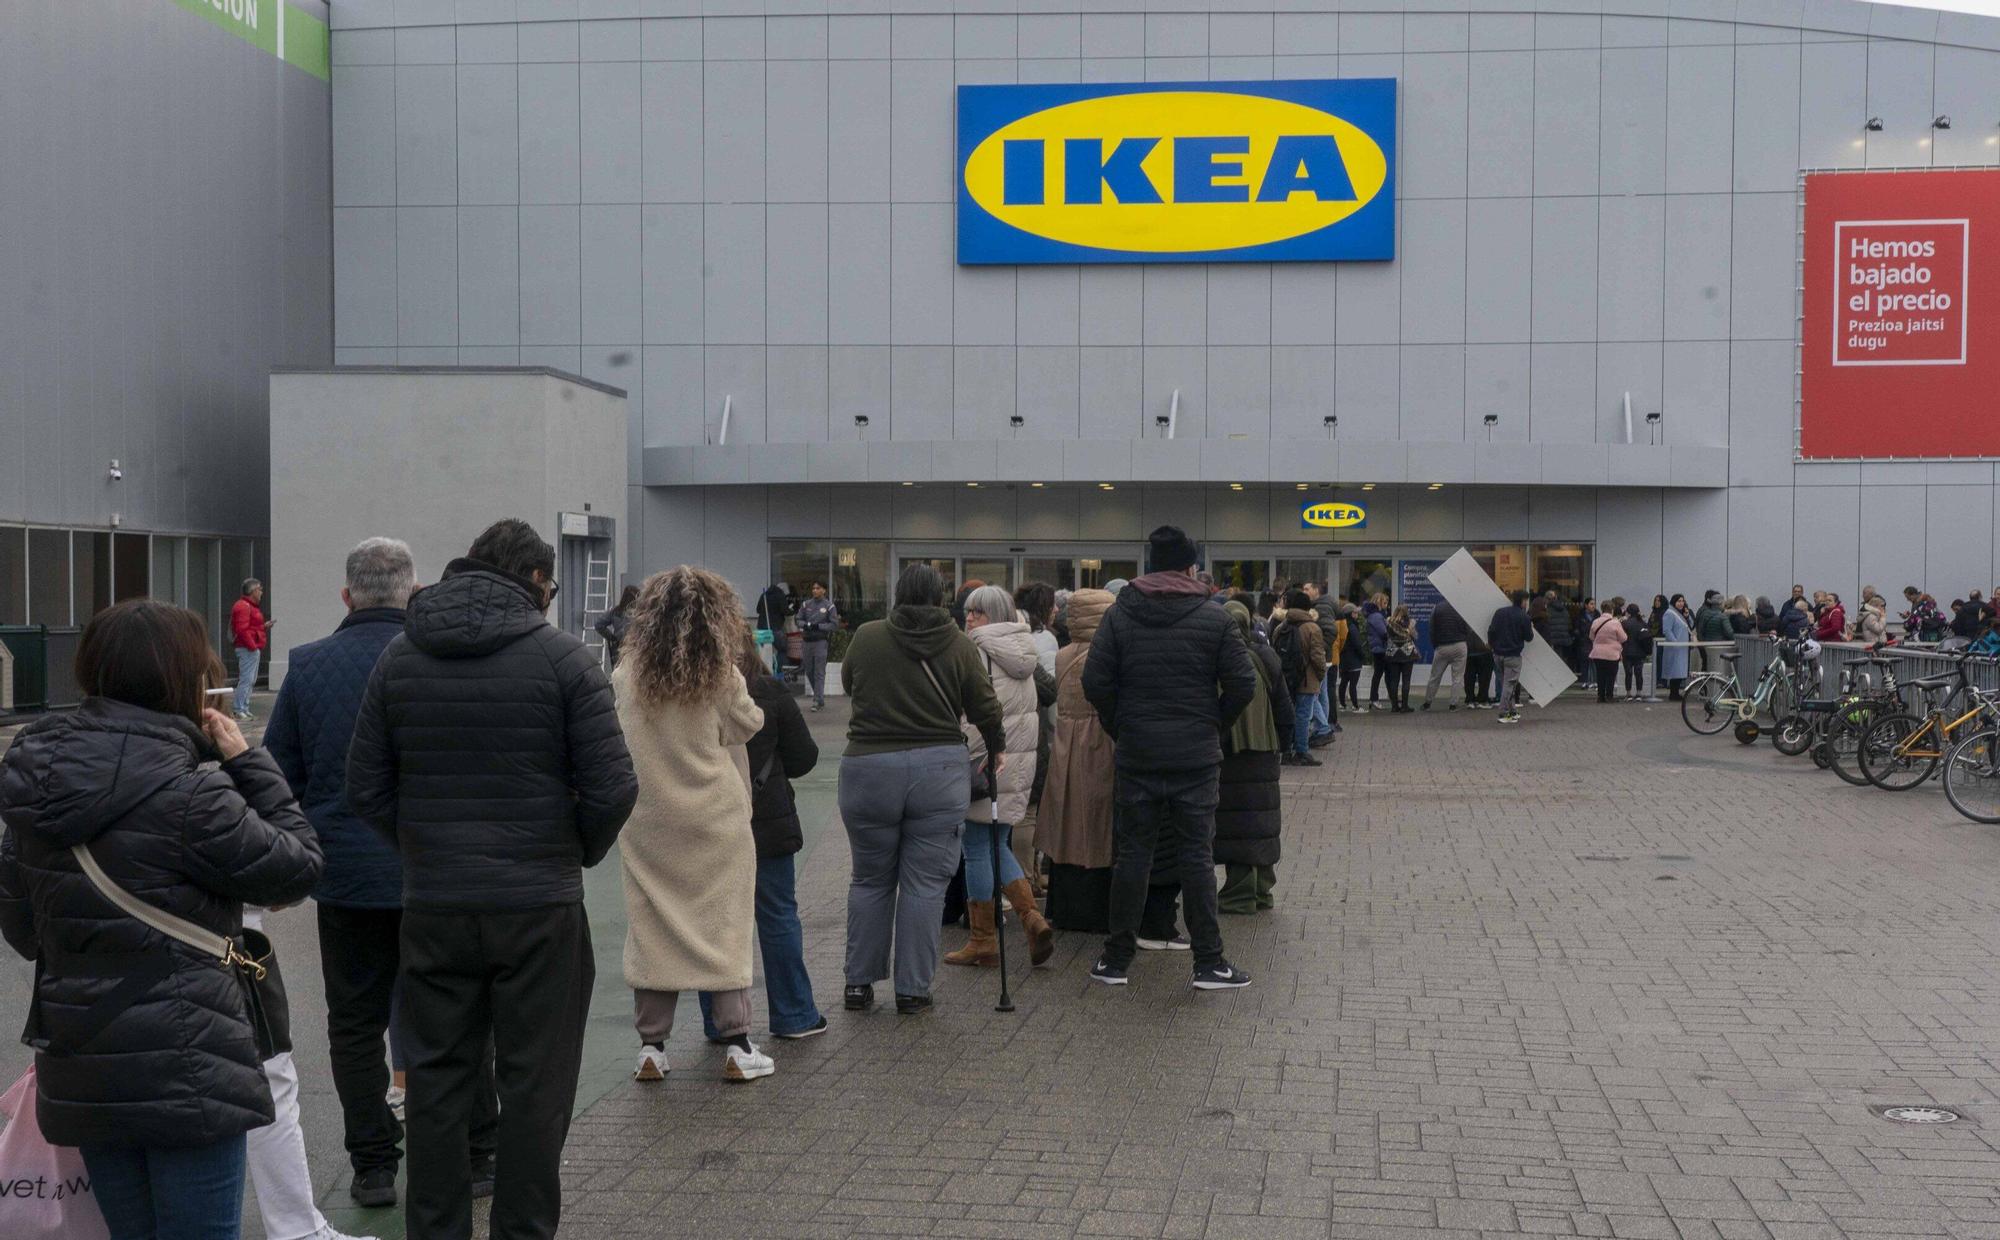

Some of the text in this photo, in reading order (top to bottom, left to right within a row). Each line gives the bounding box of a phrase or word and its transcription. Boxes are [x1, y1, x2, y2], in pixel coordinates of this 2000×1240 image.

[1003, 135, 1358, 205] IKEA
[1851, 238, 1935, 258] Hemos
[1850, 262, 1931, 290] bajado
[1849, 288, 1951, 317] el precio
[1849, 317, 1944, 334] Prezioa jaitsi
[1848, 334, 1887, 350] dugu
[1309, 510, 1360, 519] IKEA
